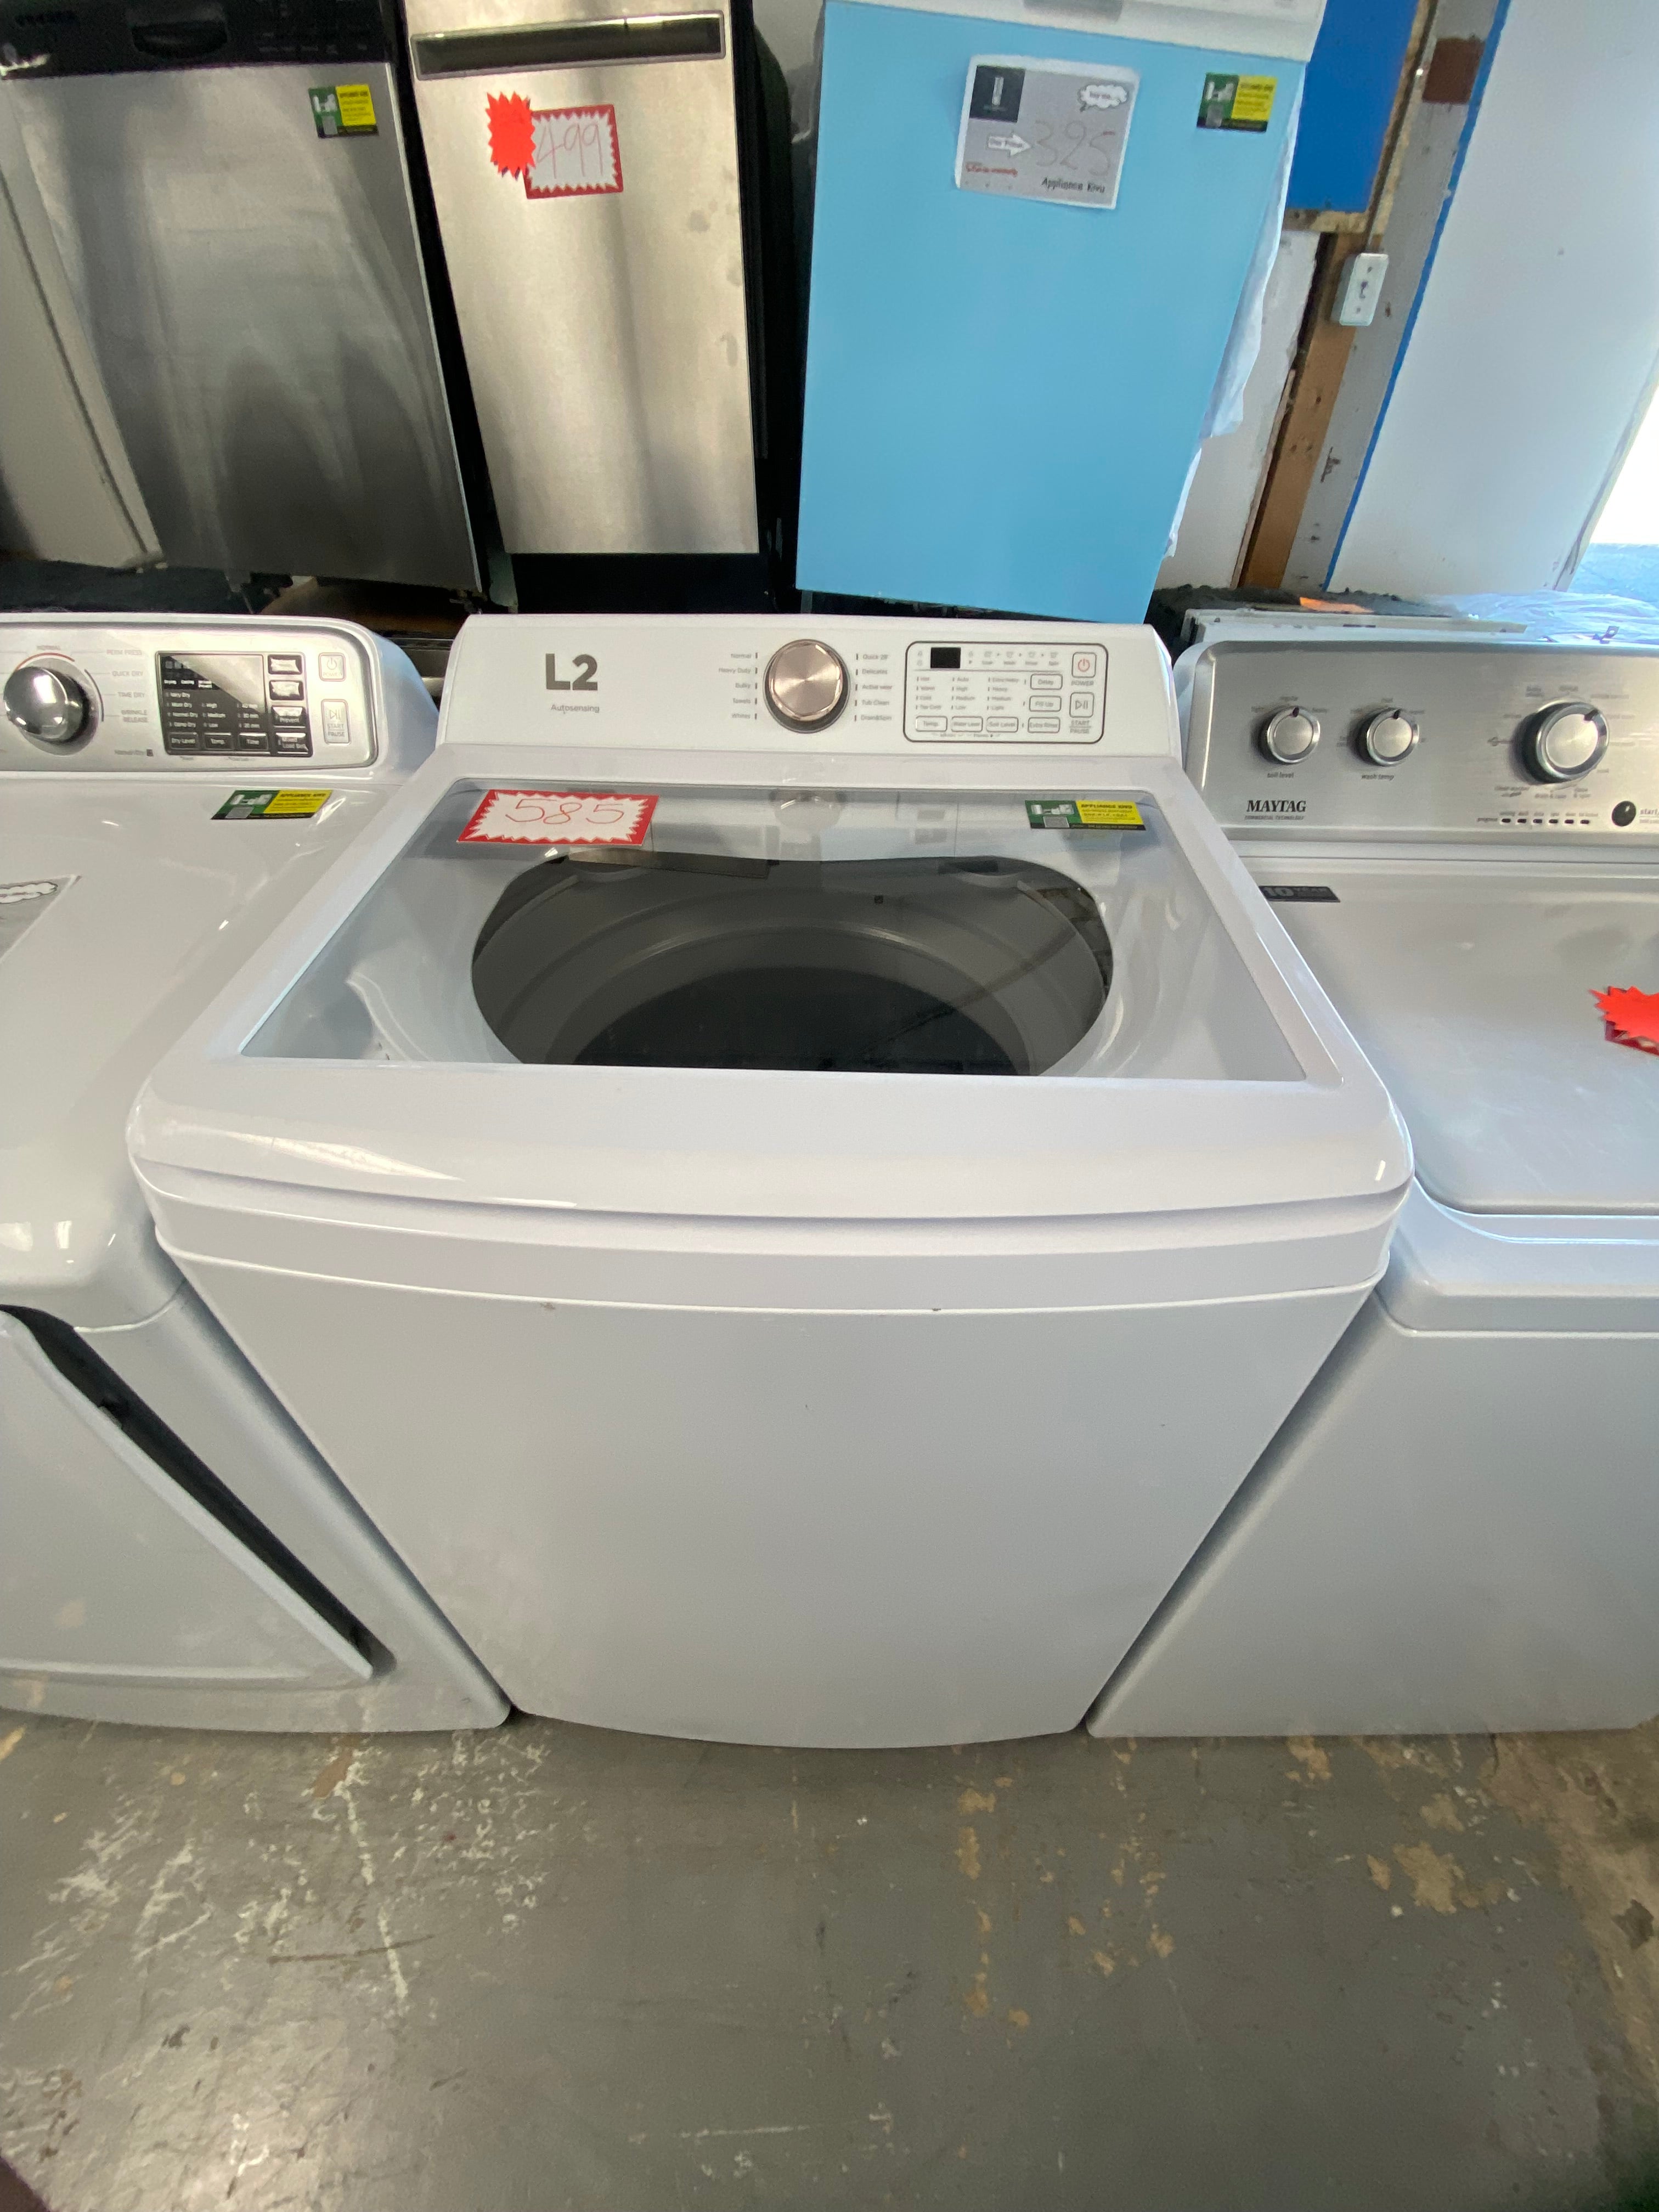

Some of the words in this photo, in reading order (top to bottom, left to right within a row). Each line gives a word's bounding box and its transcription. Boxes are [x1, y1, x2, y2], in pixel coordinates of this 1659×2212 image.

[536, 122, 603, 179] 499
[545, 653, 598, 691] L2
[550, 704, 600, 714] Autosensing
[505, 798, 624, 825] 585
[1246, 799, 1307, 812] MAYTAG
